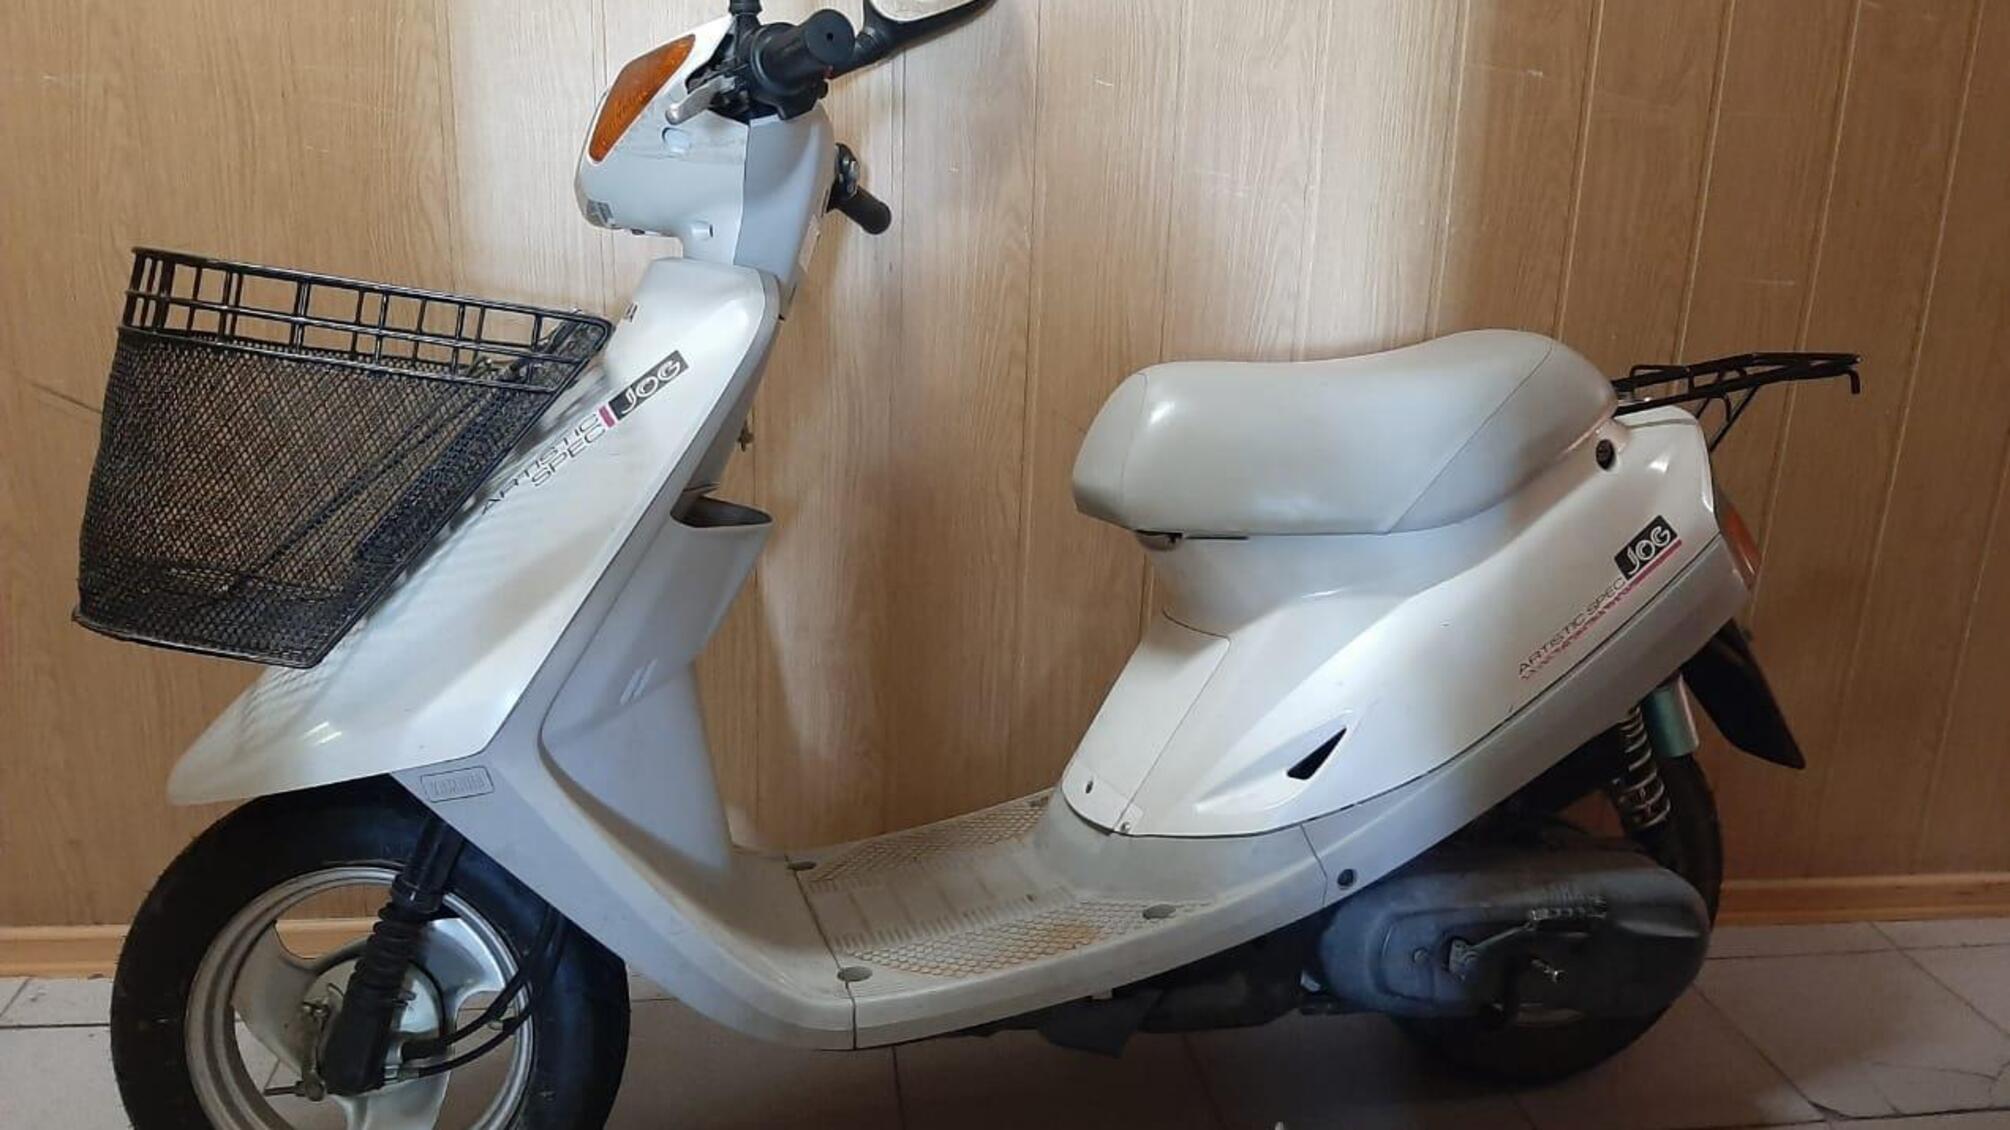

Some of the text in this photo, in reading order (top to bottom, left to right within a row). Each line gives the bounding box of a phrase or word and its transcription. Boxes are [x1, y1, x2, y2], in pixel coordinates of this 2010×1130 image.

[621, 358, 681, 415] JOG
[531, 427, 606, 487] SPEC
[1628, 525, 1671, 575] JOG
[1519, 612, 1586, 675] ARTISTIC
[1586, 577, 1626, 617] SPEC
